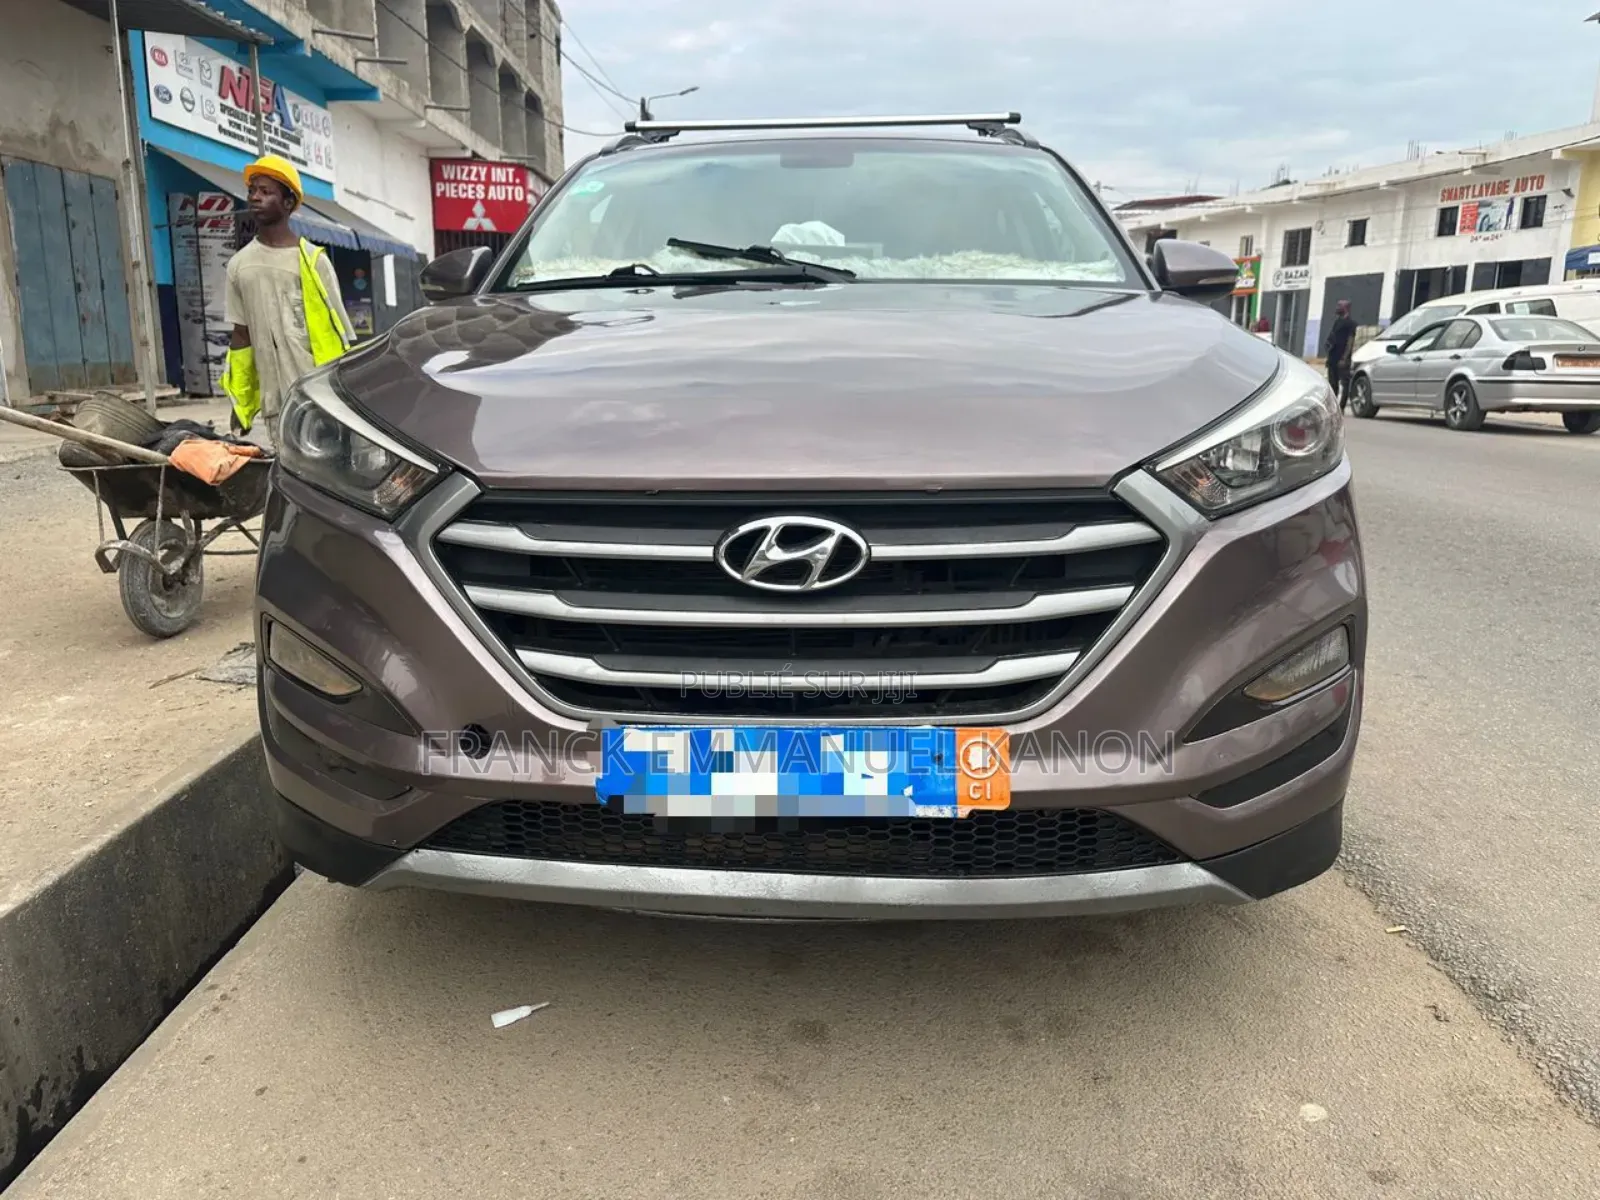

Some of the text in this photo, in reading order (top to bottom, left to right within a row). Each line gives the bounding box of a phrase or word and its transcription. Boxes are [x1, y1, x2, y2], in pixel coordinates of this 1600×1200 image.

[442, 164, 520, 184] WIZZY INT.
[1514, 174, 1546, 194] AUTO
[435, 182, 524, 202] PIECES AUTO
[1284, 269, 1310, 280] BAZAR
[969, 780, 991, 801] CI
